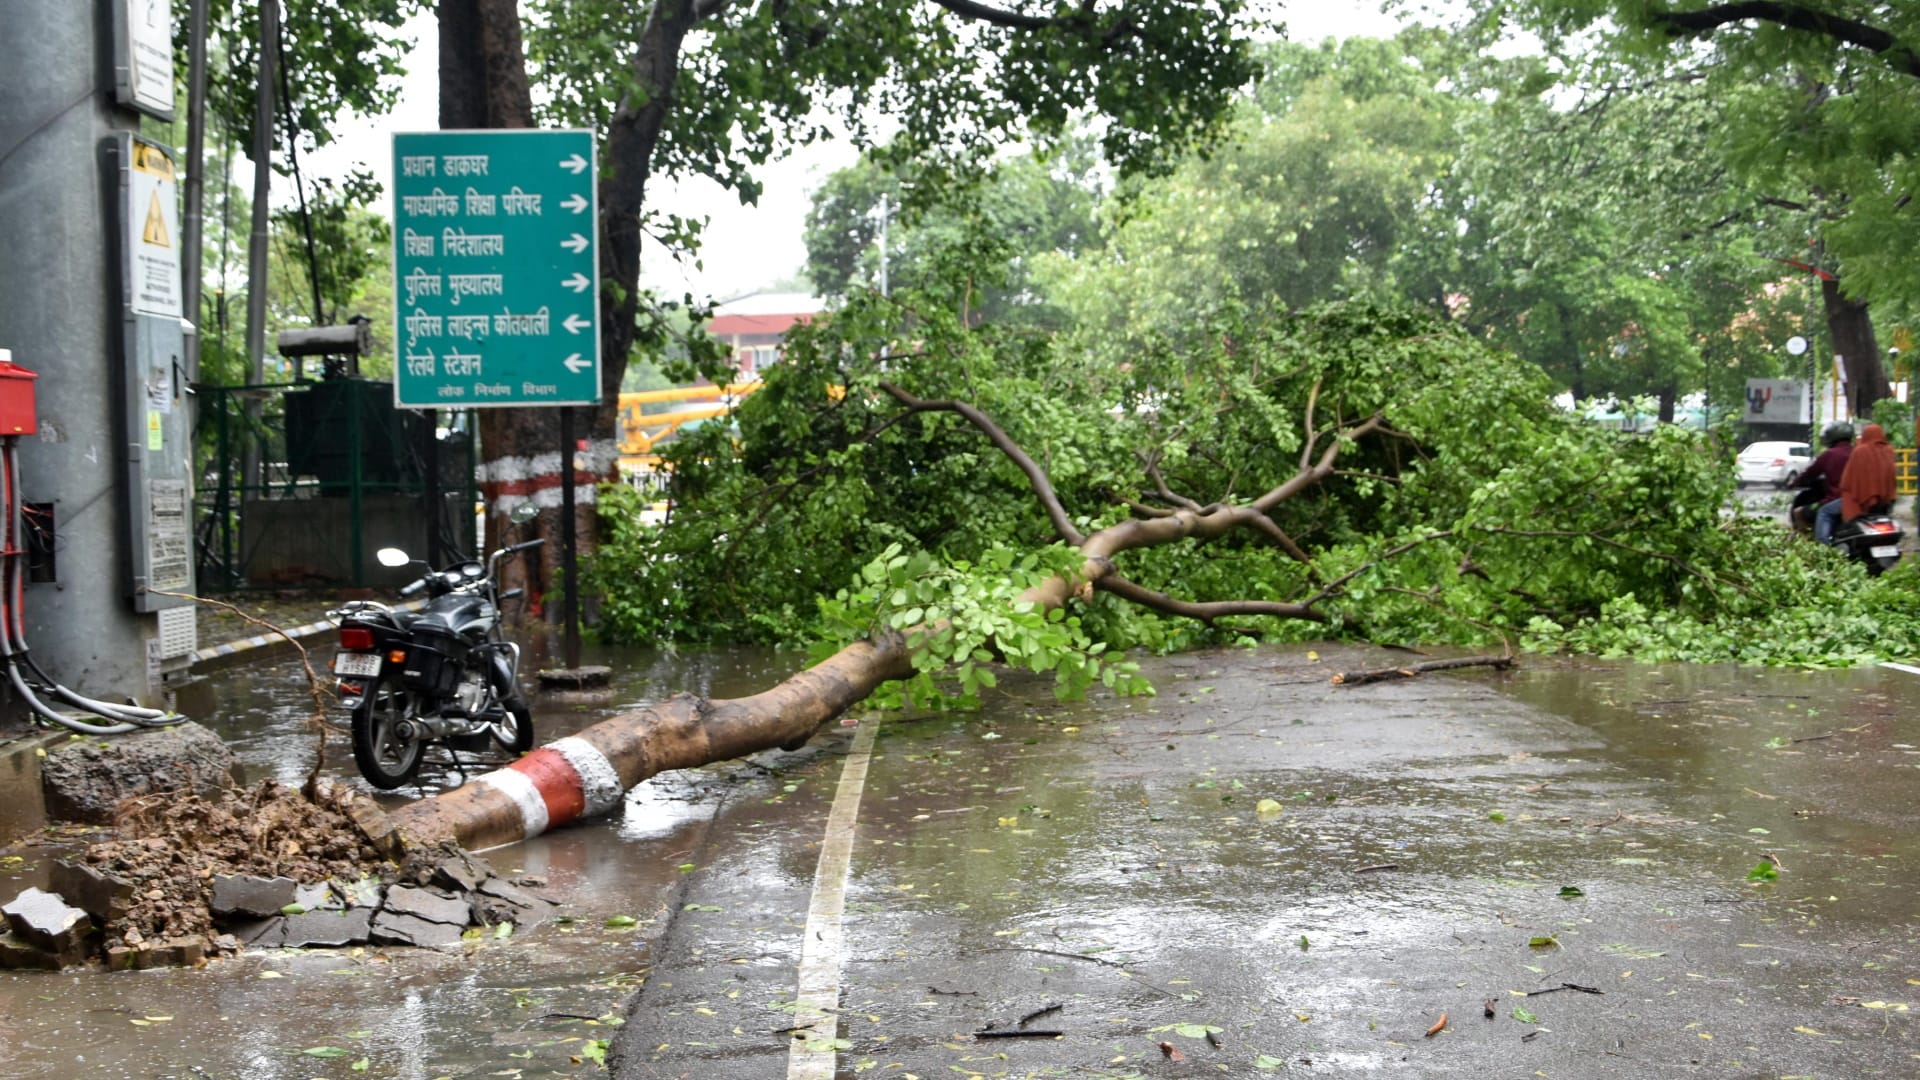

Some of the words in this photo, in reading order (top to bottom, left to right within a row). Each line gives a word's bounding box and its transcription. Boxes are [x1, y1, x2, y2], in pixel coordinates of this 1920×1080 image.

[402, 156, 436, 176] प्रधान
[443, 155, 489, 176] डाकघर
[402, 187, 459, 216] माध्यमिक
[465, 187, 496, 216] शिक्षा
[403, 228, 434, 256] शिक्षा
[442, 227, 504, 256] निदेशालय
[404, 267, 442, 306] पुलिस
[448, 274, 503, 305] मुख्यालय
[405, 307, 442, 347] पुलिस
[493, 306, 550, 335] कोतवाली
[406, 347, 435, 376] रेलवे
[443, 347, 482, 375] स्टेशन
